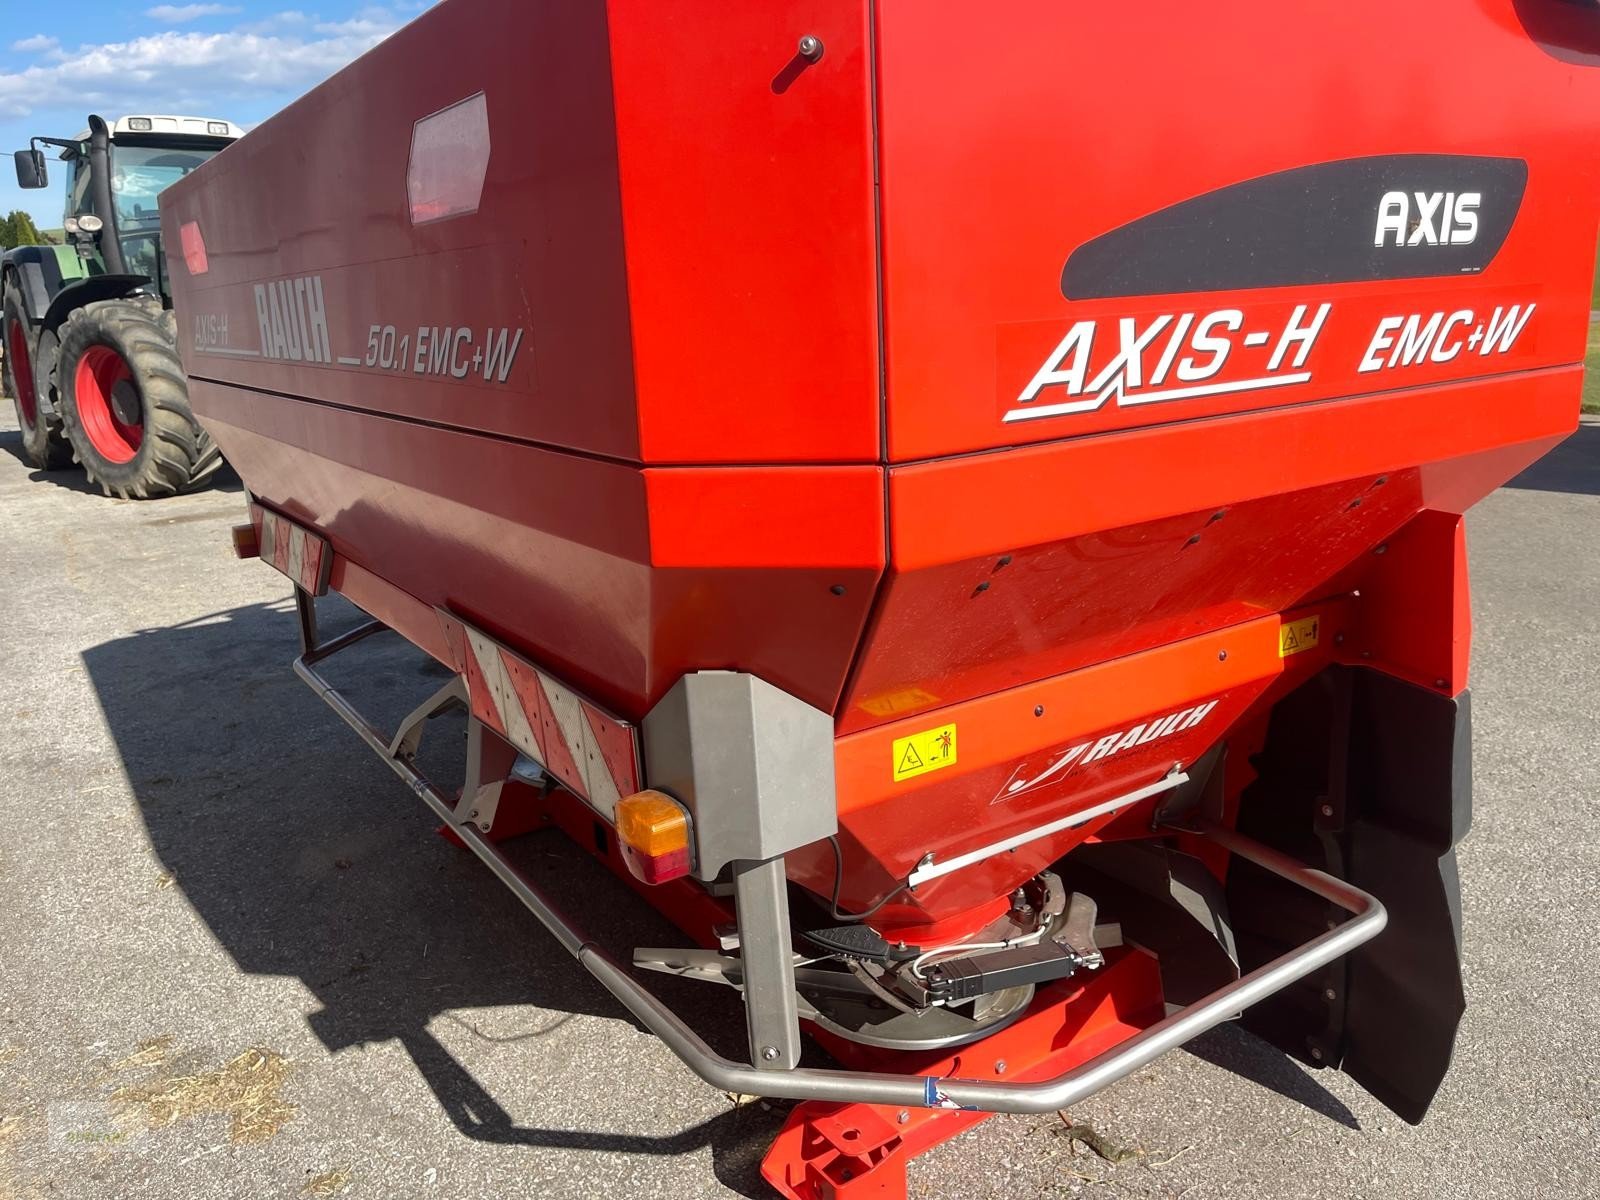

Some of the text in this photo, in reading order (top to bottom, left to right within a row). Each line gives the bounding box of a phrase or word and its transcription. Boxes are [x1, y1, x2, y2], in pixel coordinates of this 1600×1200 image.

[1374, 191, 1482, 247] AXIS
[194, 275, 523, 382] AXIS-H RAUCH 50.1 EMC+W
[1016, 303, 1537, 402] AXIS-H EMC+W
[1079, 699, 1219, 765] RAUCH
